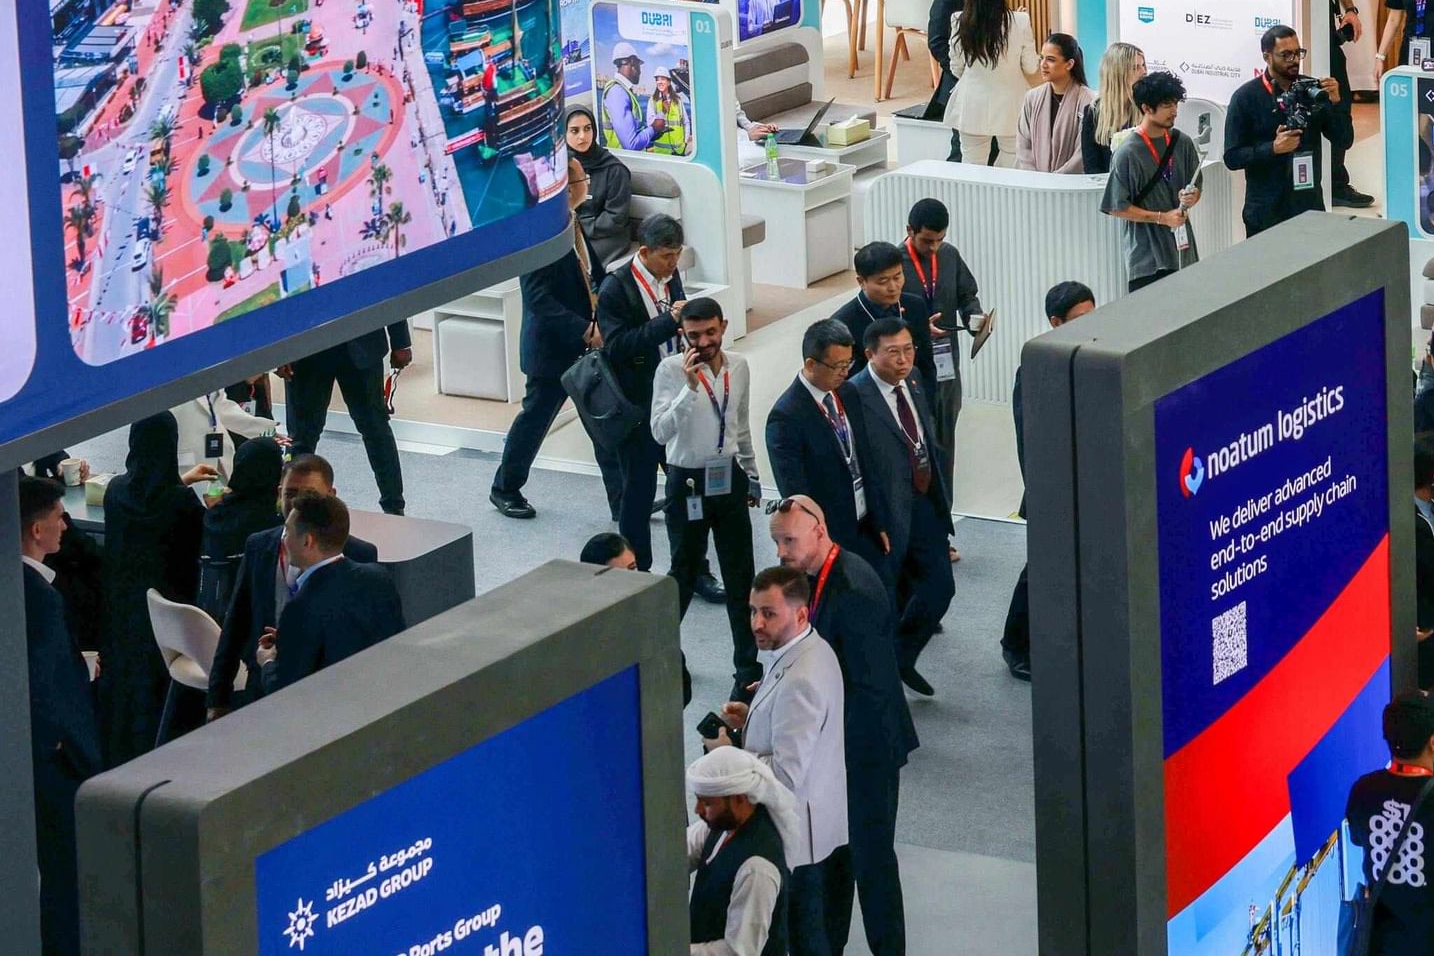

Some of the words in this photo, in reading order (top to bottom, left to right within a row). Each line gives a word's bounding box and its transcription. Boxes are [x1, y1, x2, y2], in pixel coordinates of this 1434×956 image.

[641, 11, 672, 27] DUBAI
[696, 20, 711, 33] 01
[1390, 83, 1408, 96] 05
[1207, 423, 1274, 480] noatum
[1278, 385, 1344, 441] logistics
[1210, 515, 1230, 541] We
[1232, 493, 1273, 529] deliver
[1275, 455, 1332, 506] advanced
[1211, 512, 1284, 570] end-to-end
[1285, 492, 1324, 528] supply
[1326, 475, 1356, 505] chain
[1211, 555, 1268, 600] solutions
[379, 837, 432, 873] مجموعة
[326, 886, 378, 928] KEZAD
[379, 857, 433, 899] GROUP
[453, 904, 502, 940] Group
